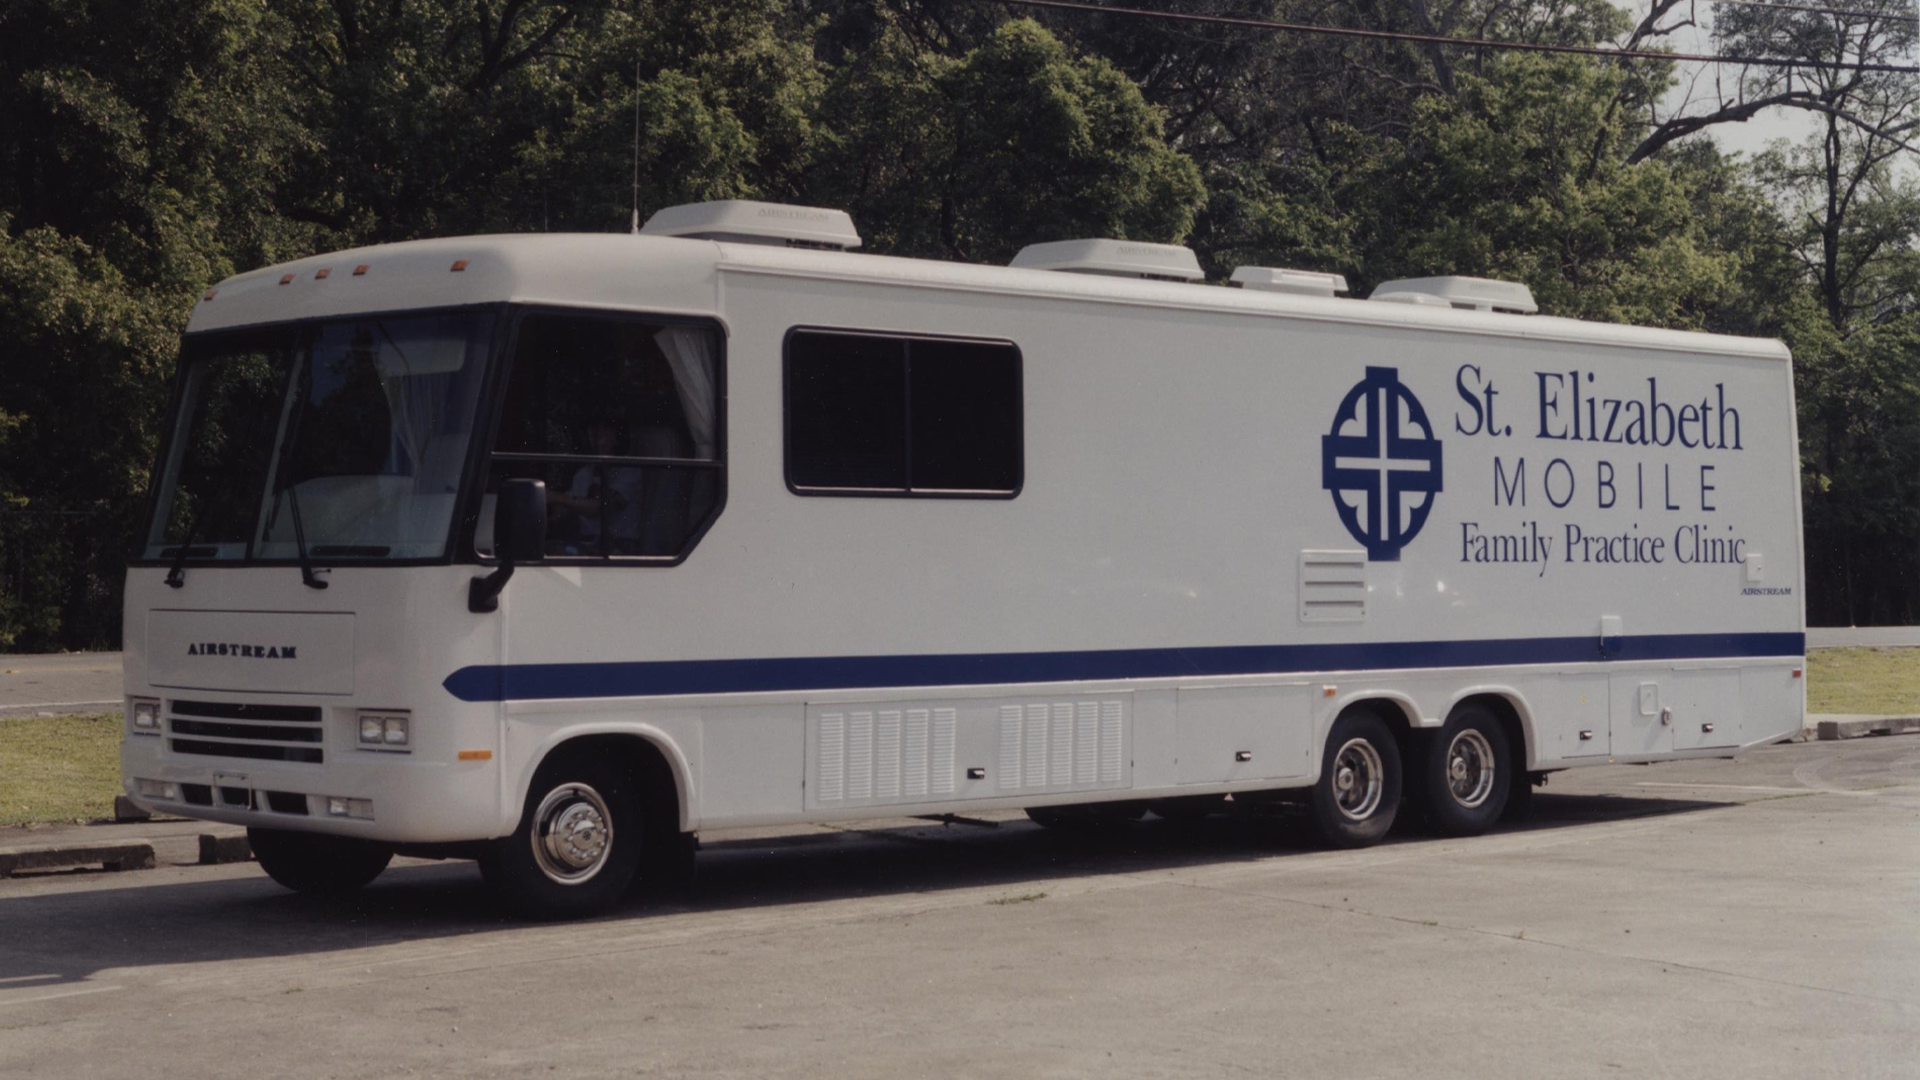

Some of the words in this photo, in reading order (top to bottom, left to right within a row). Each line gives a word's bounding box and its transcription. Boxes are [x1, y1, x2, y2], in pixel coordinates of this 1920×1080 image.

[1455, 363, 1513, 438] St.
[1533, 369, 1744, 451] Elizabeth
[1493, 455, 1717, 512] MOBILE
[1459, 520, 1553, 578] Family
[1564, 522, 1666, 564] Practice
[1673, 523, 1746, 565] Clinic
[1741, 587, 1792, 596] AIRSTREAM
[187, 642, 297, 659] AIRSTREAM
